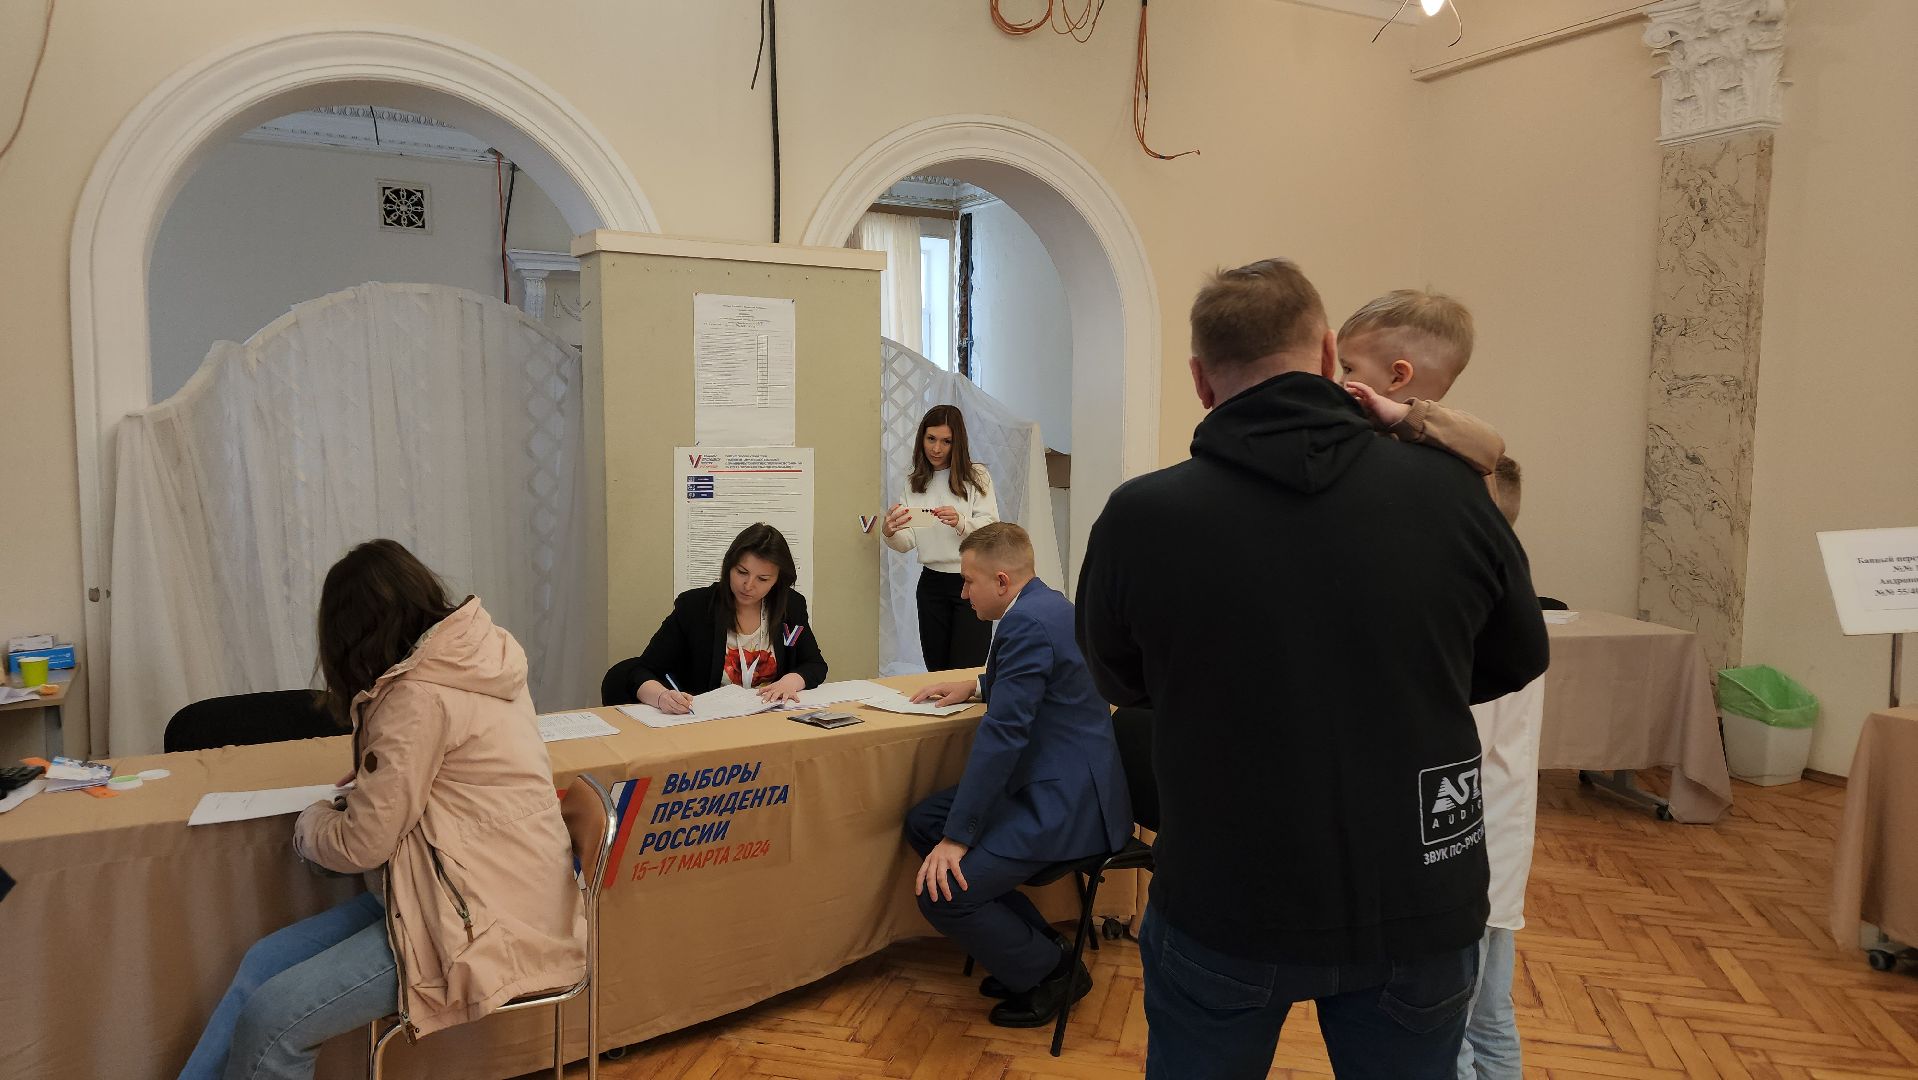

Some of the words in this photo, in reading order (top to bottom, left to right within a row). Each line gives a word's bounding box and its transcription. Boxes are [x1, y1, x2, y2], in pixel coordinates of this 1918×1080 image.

[661, 761, 762, 796] ВЫБОРЫ
[650, 784, 790, 825] ПРЕЗИДЕНТА
[638, 820, 731, 856] РОССИИ
[677, 846, 731, 874] МАРТА
[732, 839, 771, 864] 2024
[1423, 847, 1449, 866] ЗВУК
